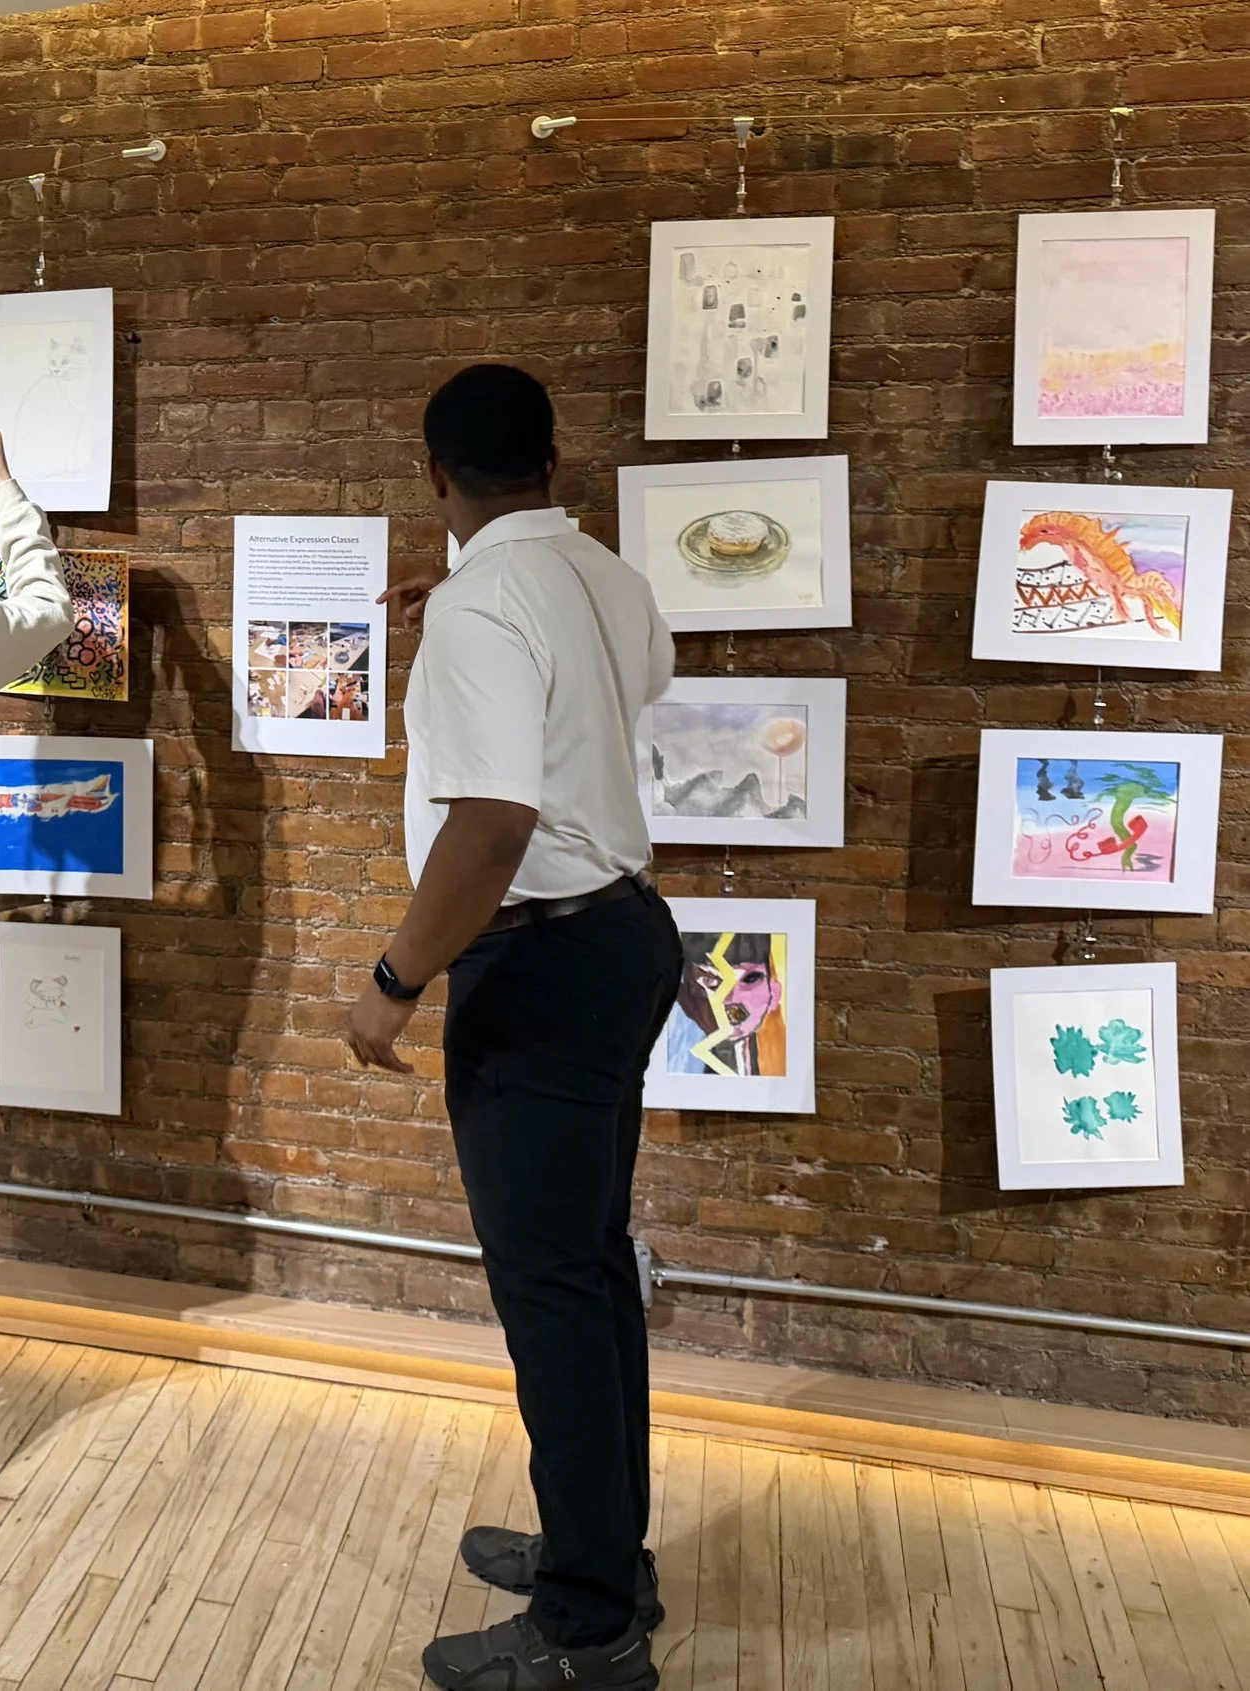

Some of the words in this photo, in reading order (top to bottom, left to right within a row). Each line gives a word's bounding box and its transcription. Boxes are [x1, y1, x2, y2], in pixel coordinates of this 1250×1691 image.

[249, 535, 288, 543] Alternative
[290, 535, 330, 545] Expression
[331, 536, 359, 544] Classes
